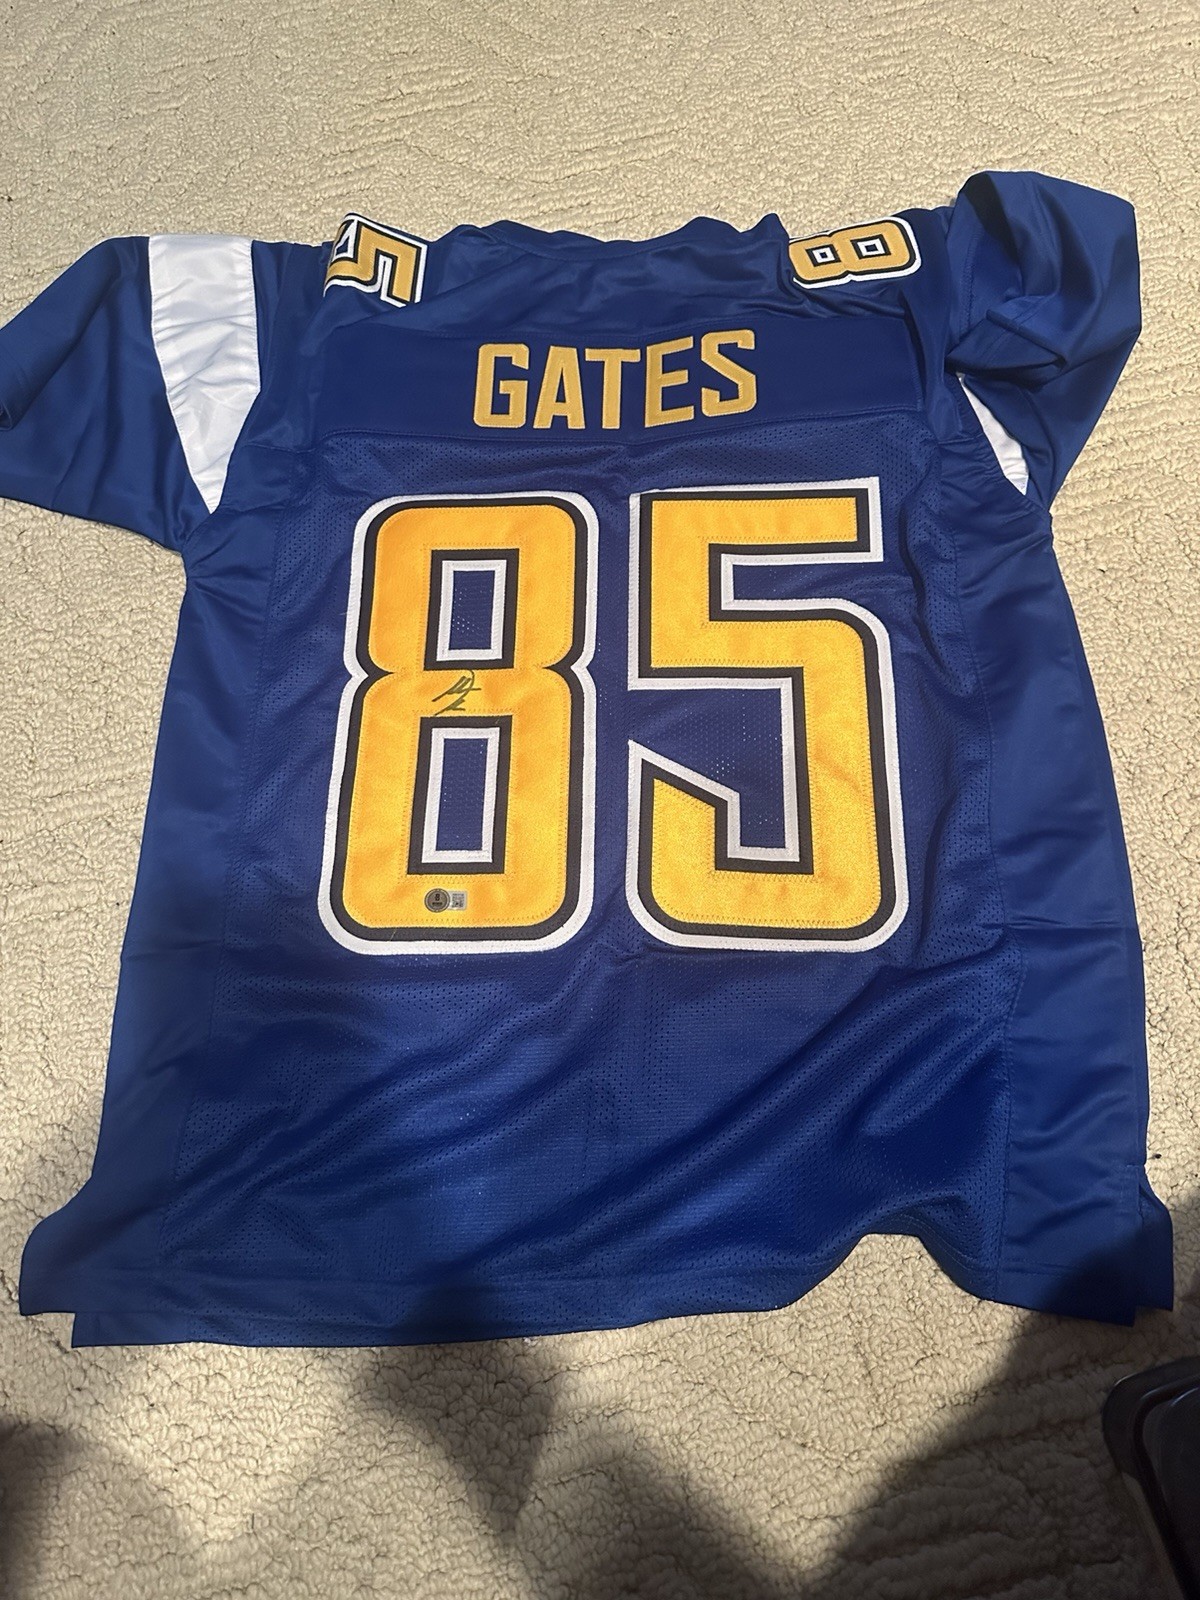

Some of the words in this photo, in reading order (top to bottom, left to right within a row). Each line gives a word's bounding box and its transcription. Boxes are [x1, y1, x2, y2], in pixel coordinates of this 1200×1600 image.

[323, 212, 427, 307] 5
[788, 216, 922, 290] 8
[473, 329, 757, 430] GATES
[318, 477, 909, 955] 85
